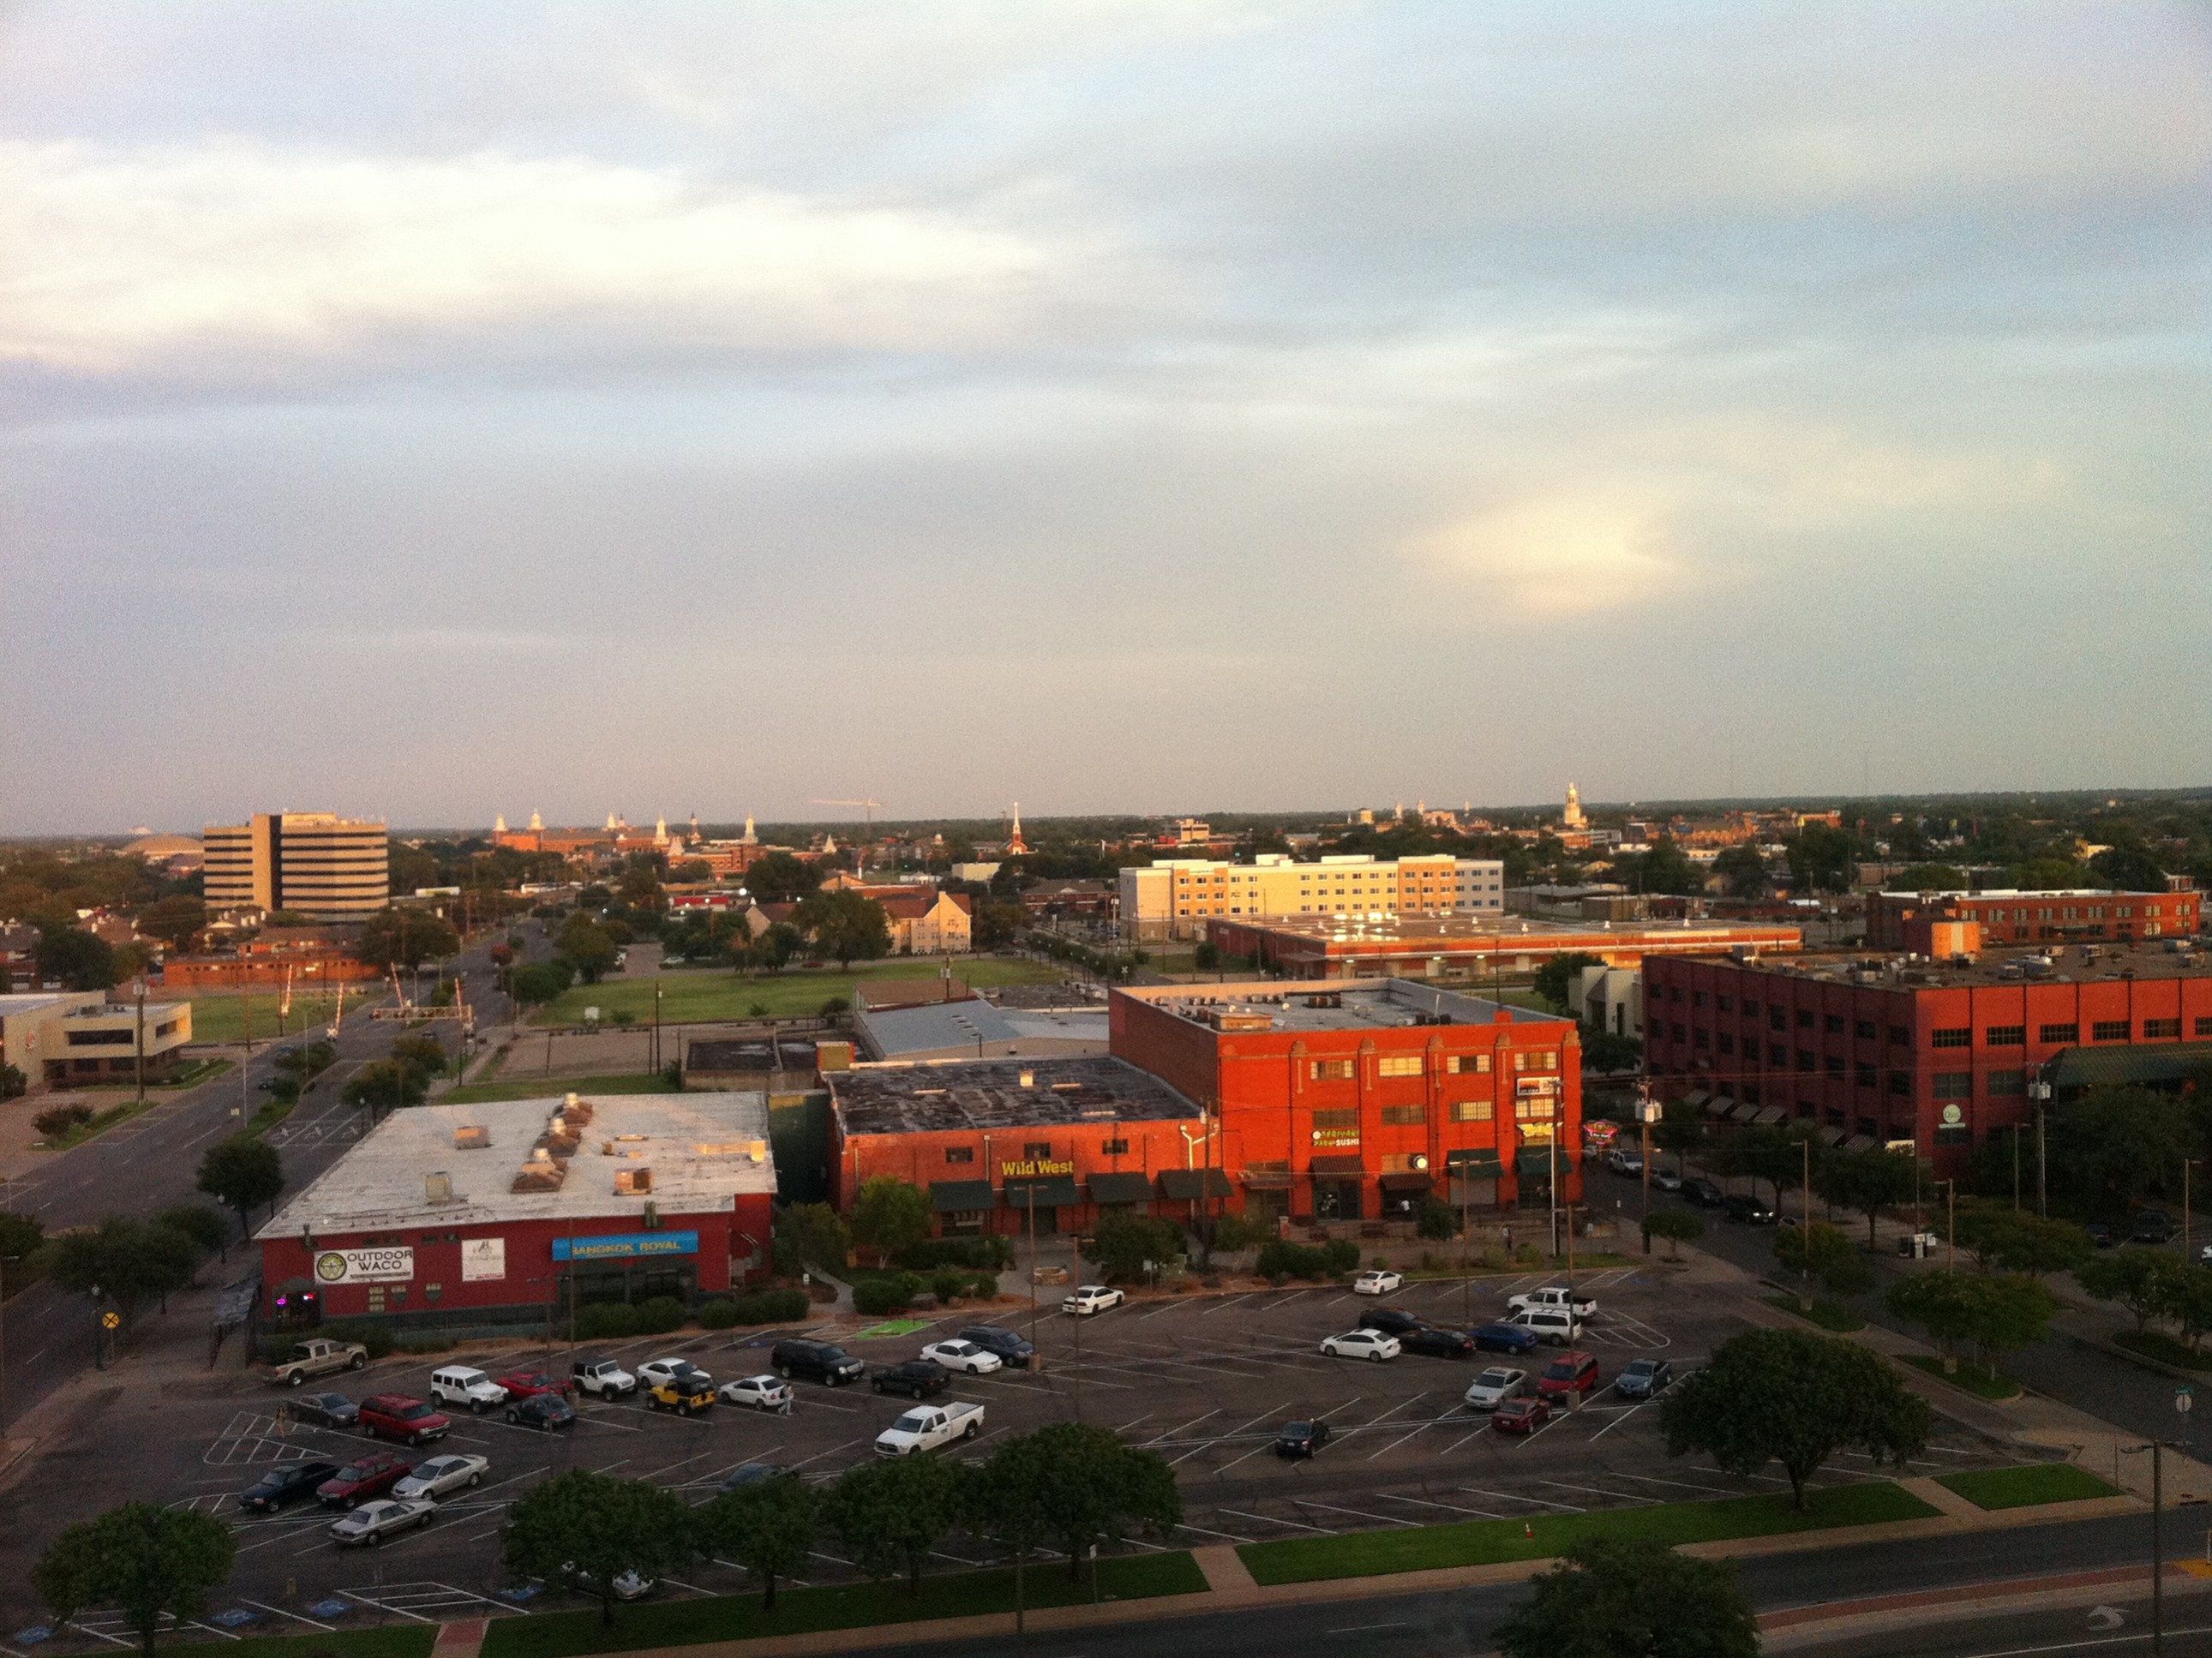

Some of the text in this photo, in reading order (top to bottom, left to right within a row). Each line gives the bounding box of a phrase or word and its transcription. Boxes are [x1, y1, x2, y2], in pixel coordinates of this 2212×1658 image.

[1335, 1138, 1359, 1146] SUSHI
[1001, 1159, 1074, 1176] Wild West
[572, 1243, 633, 1255] BANGKOK
[639, 1241, 681, 1251] ROYAL
[347, 1250, 412, 1262] OUTDOOR
[358, 1260, 402, 1271] WACO
